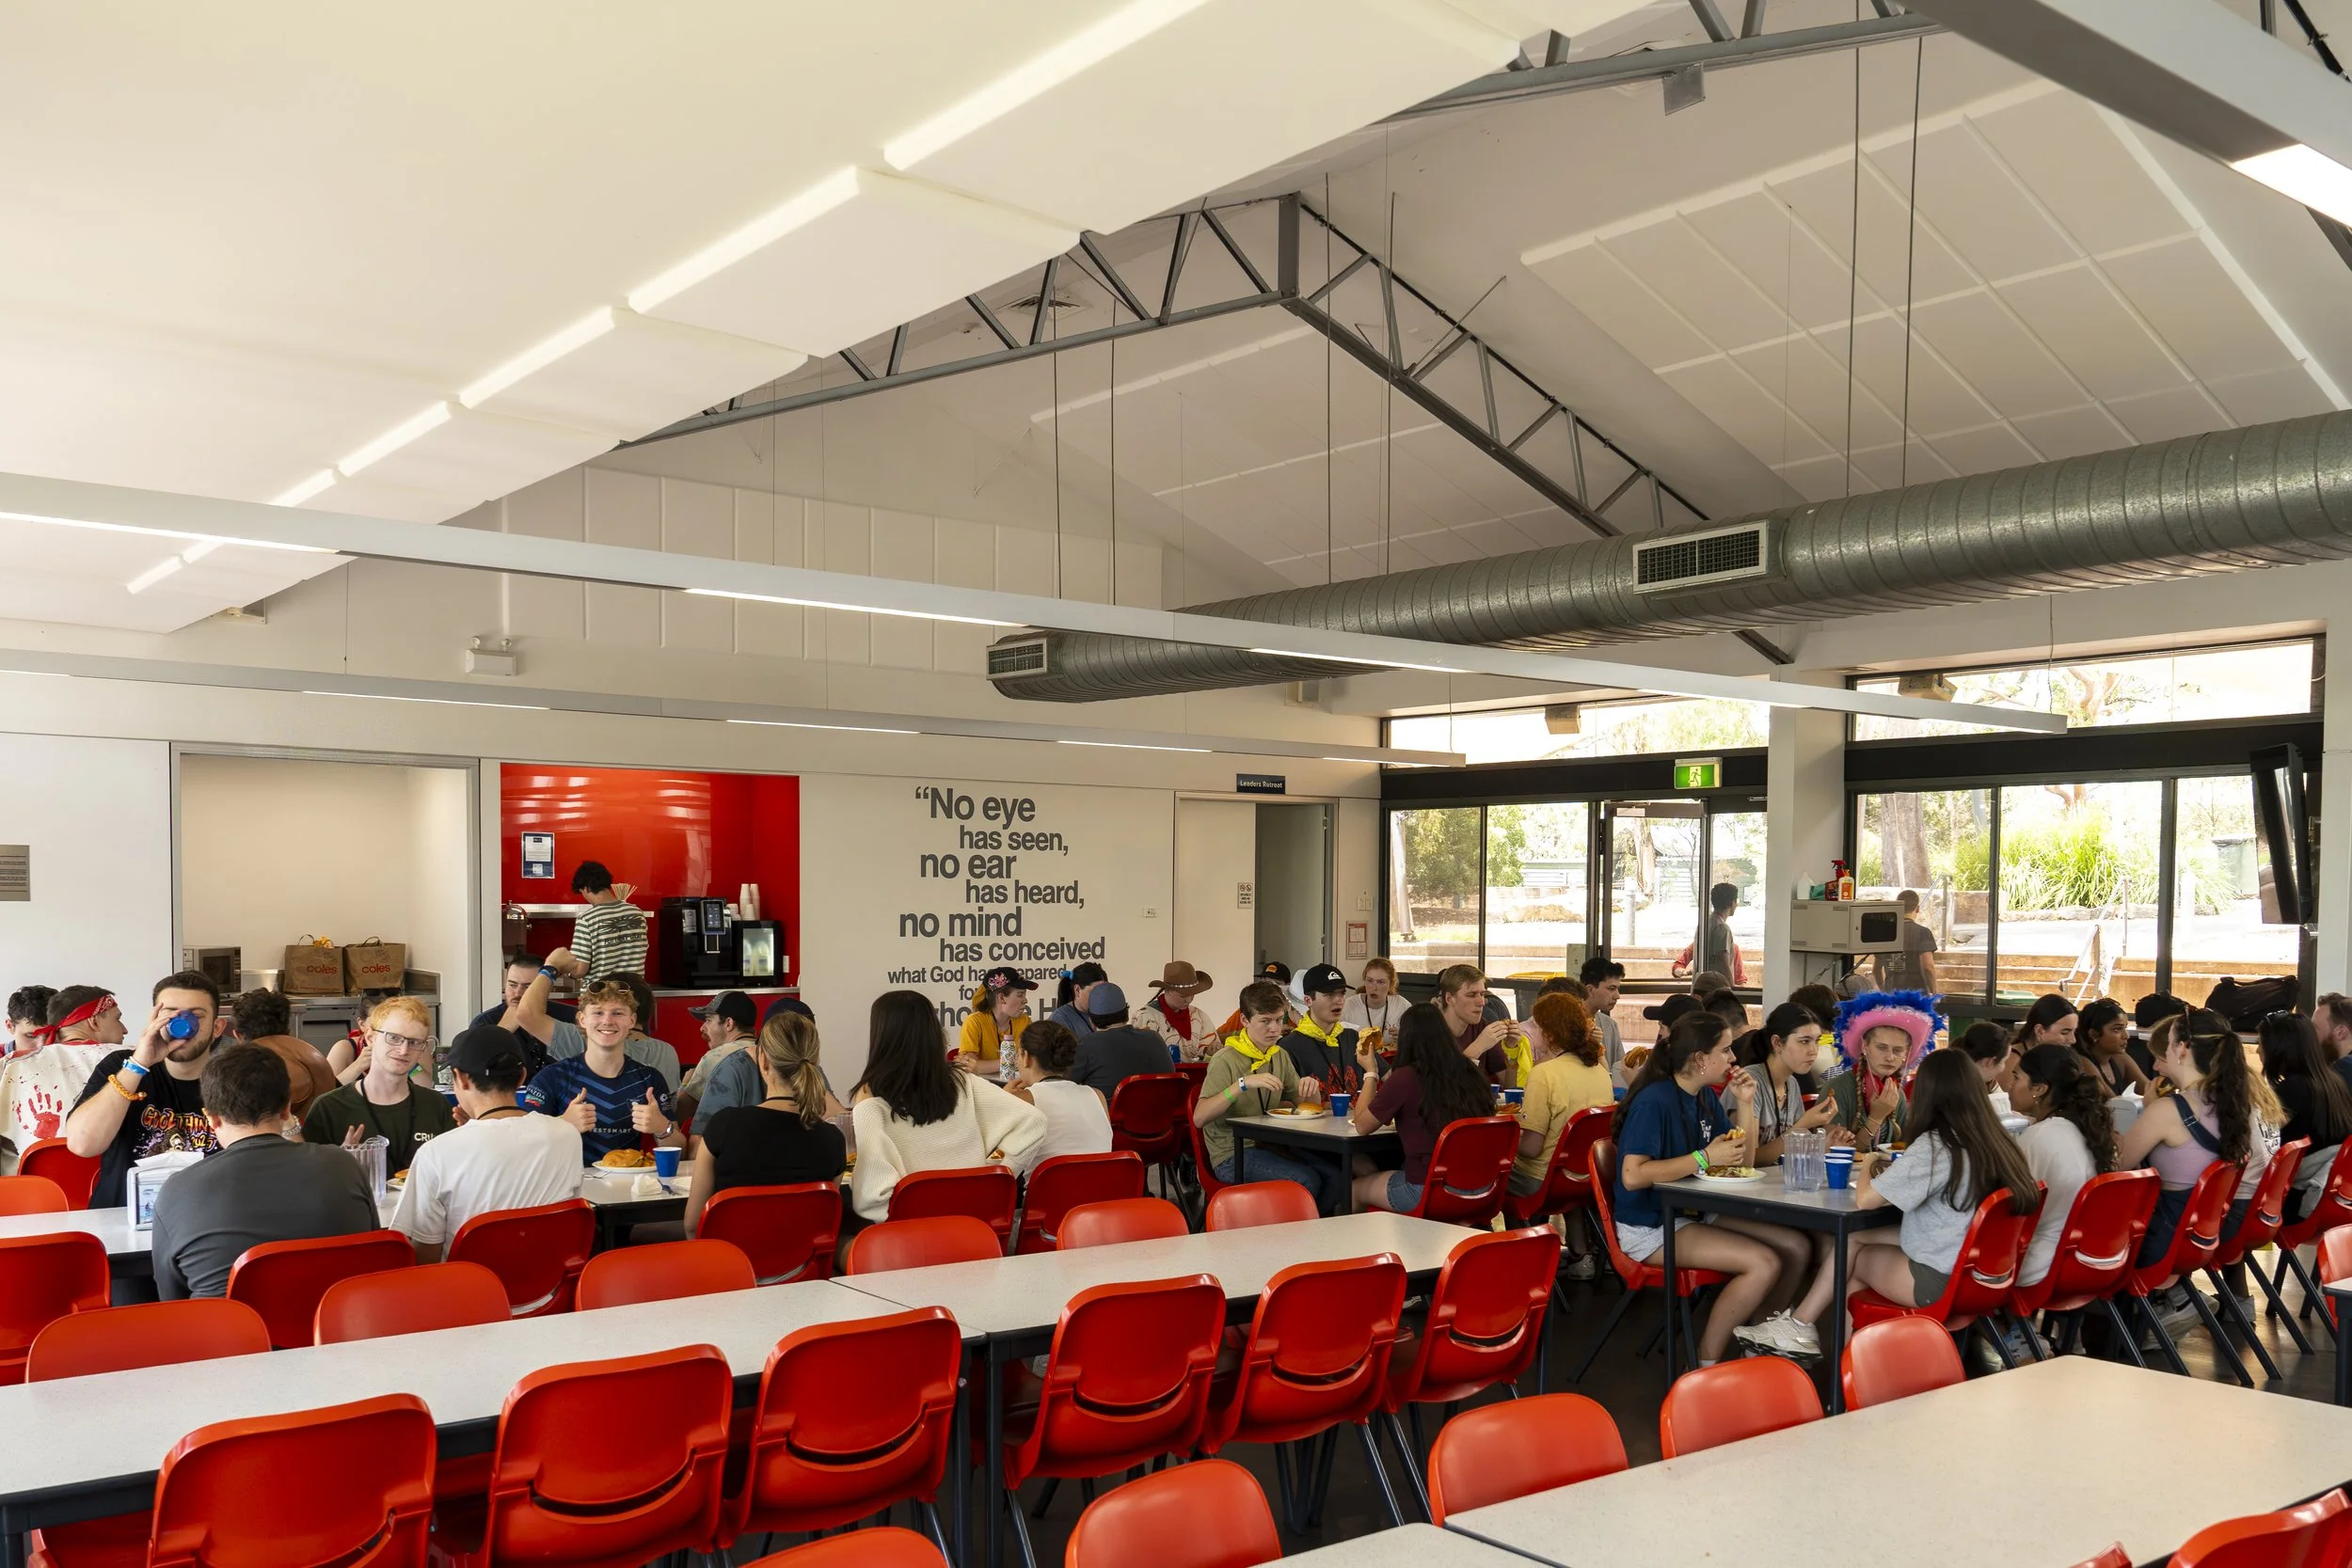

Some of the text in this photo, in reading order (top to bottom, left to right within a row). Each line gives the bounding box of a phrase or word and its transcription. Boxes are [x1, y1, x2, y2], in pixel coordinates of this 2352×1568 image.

[982, 796, 1036, 830] eye
[960, 824, 1069, 857] has seen,
[920, 853, 1017, 879] no ear
[965, 879, 1085, 910] has heard,
[899, 906, 1022, 938] no mind
[940, 936, 1105, 962] has conceived
[306, 964, 338, 974] coles
[361, 963, 390, 974] coles
[887, 963, 1067, 984] what God ha epared
[959, 984, 978, 1001] fo
[934, 1001, 973, 1027] ho
